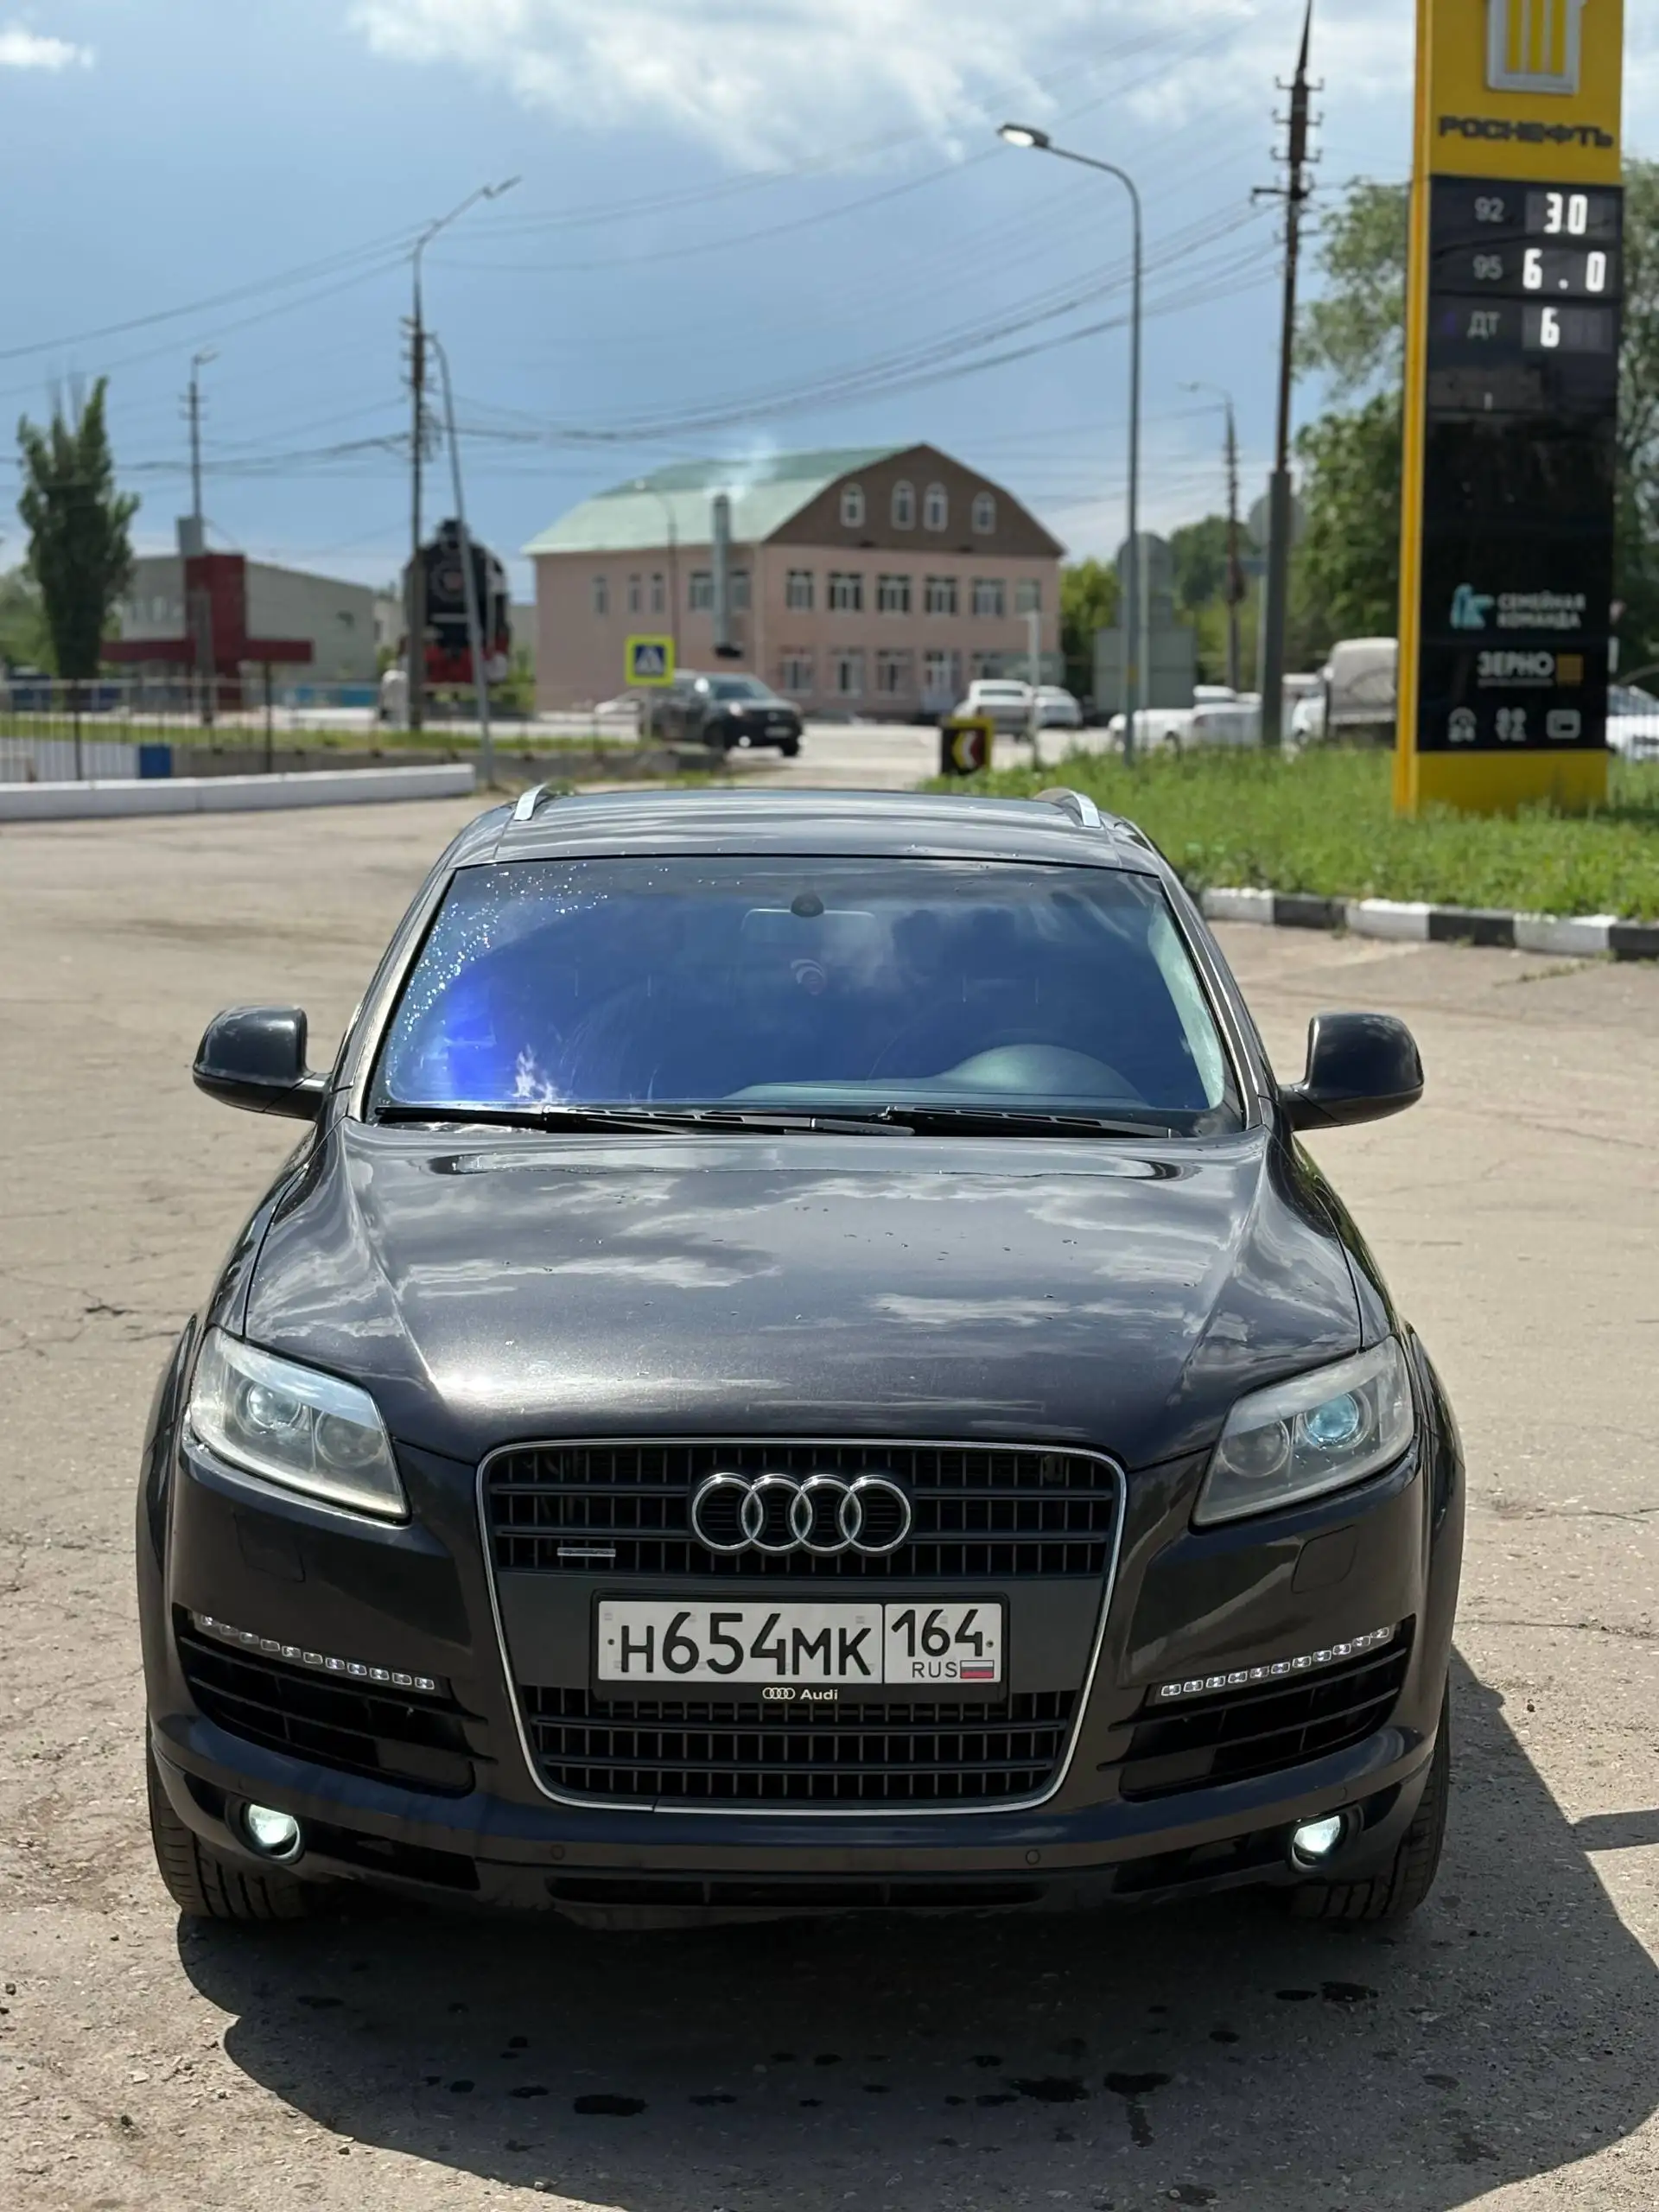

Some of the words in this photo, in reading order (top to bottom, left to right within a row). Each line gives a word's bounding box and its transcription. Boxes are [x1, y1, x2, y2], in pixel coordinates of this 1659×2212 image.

[1439, 115, 1613, 148] РОСНЕФТЬ
[1474, 196, 1505, 222] 92
[1543, 192, 1588, 235] 30
[1472, 254, 1503, 280] 95
[1467, 310, 1500, 340] ДТ
[1540, 306, 1560, 347] 6
[1477, 651, 1554, 677] ЗЕРНО
[621, 1611, 872, 1675] Н654МК
[891, 1609, 983, 1657] 164
[912, 1662, 958, 1678] RUS
[800, 1688, 838, 1700] Audi
